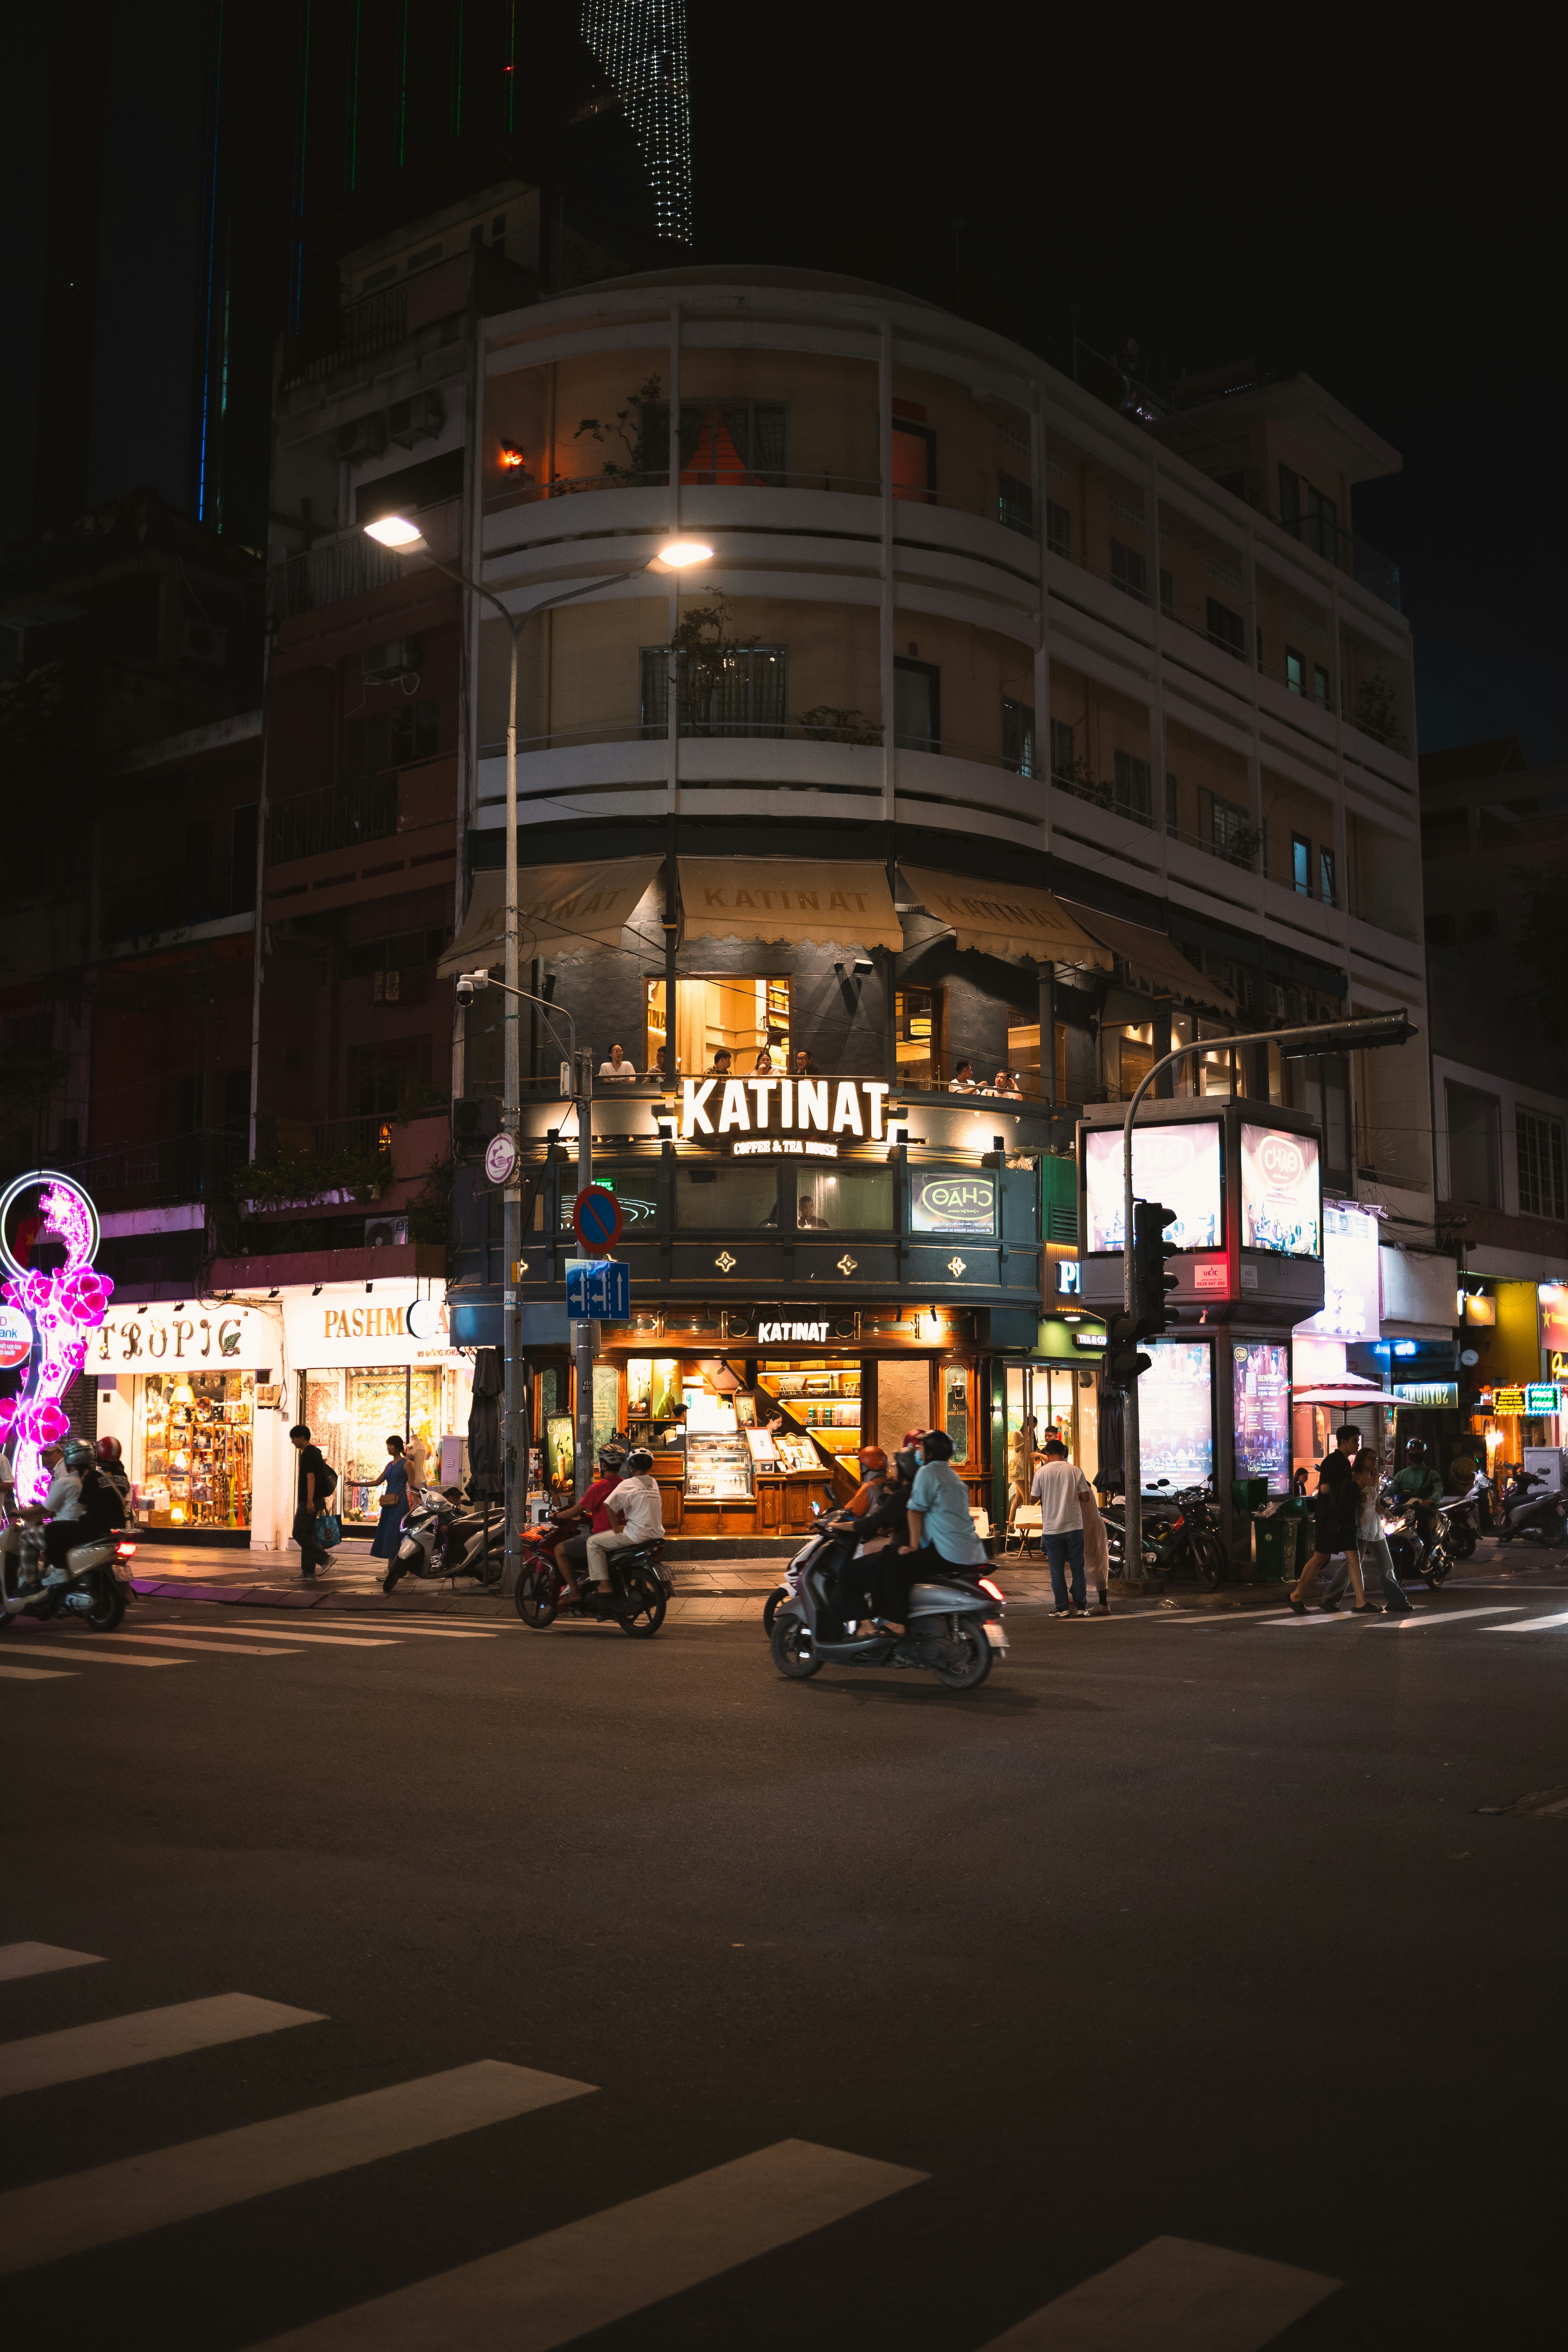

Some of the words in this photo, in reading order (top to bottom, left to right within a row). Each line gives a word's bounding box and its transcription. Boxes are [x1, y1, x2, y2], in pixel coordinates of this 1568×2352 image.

[703, 888, 869, 912] KATINAT
[934, 894, 1067, 930] KATINAT
[682, 1080, 889, 1139] KATINAT
[734, 1141, 770, 1154] COFFEE
[772, 1141, 782, 1152] &
[782, 1141, 803, 1153] TEA
[805, 1142, 837, 1157] HOUSE
[323, 1304, 450, 1337] PASHMA
[758, 1322, 829, 1343] KATINAT
[97, 1319, 242, 1360] TROPIC
[1079, 1335, 1091, 1343] TEA
[1091, 1336, 1097, 1344] &
